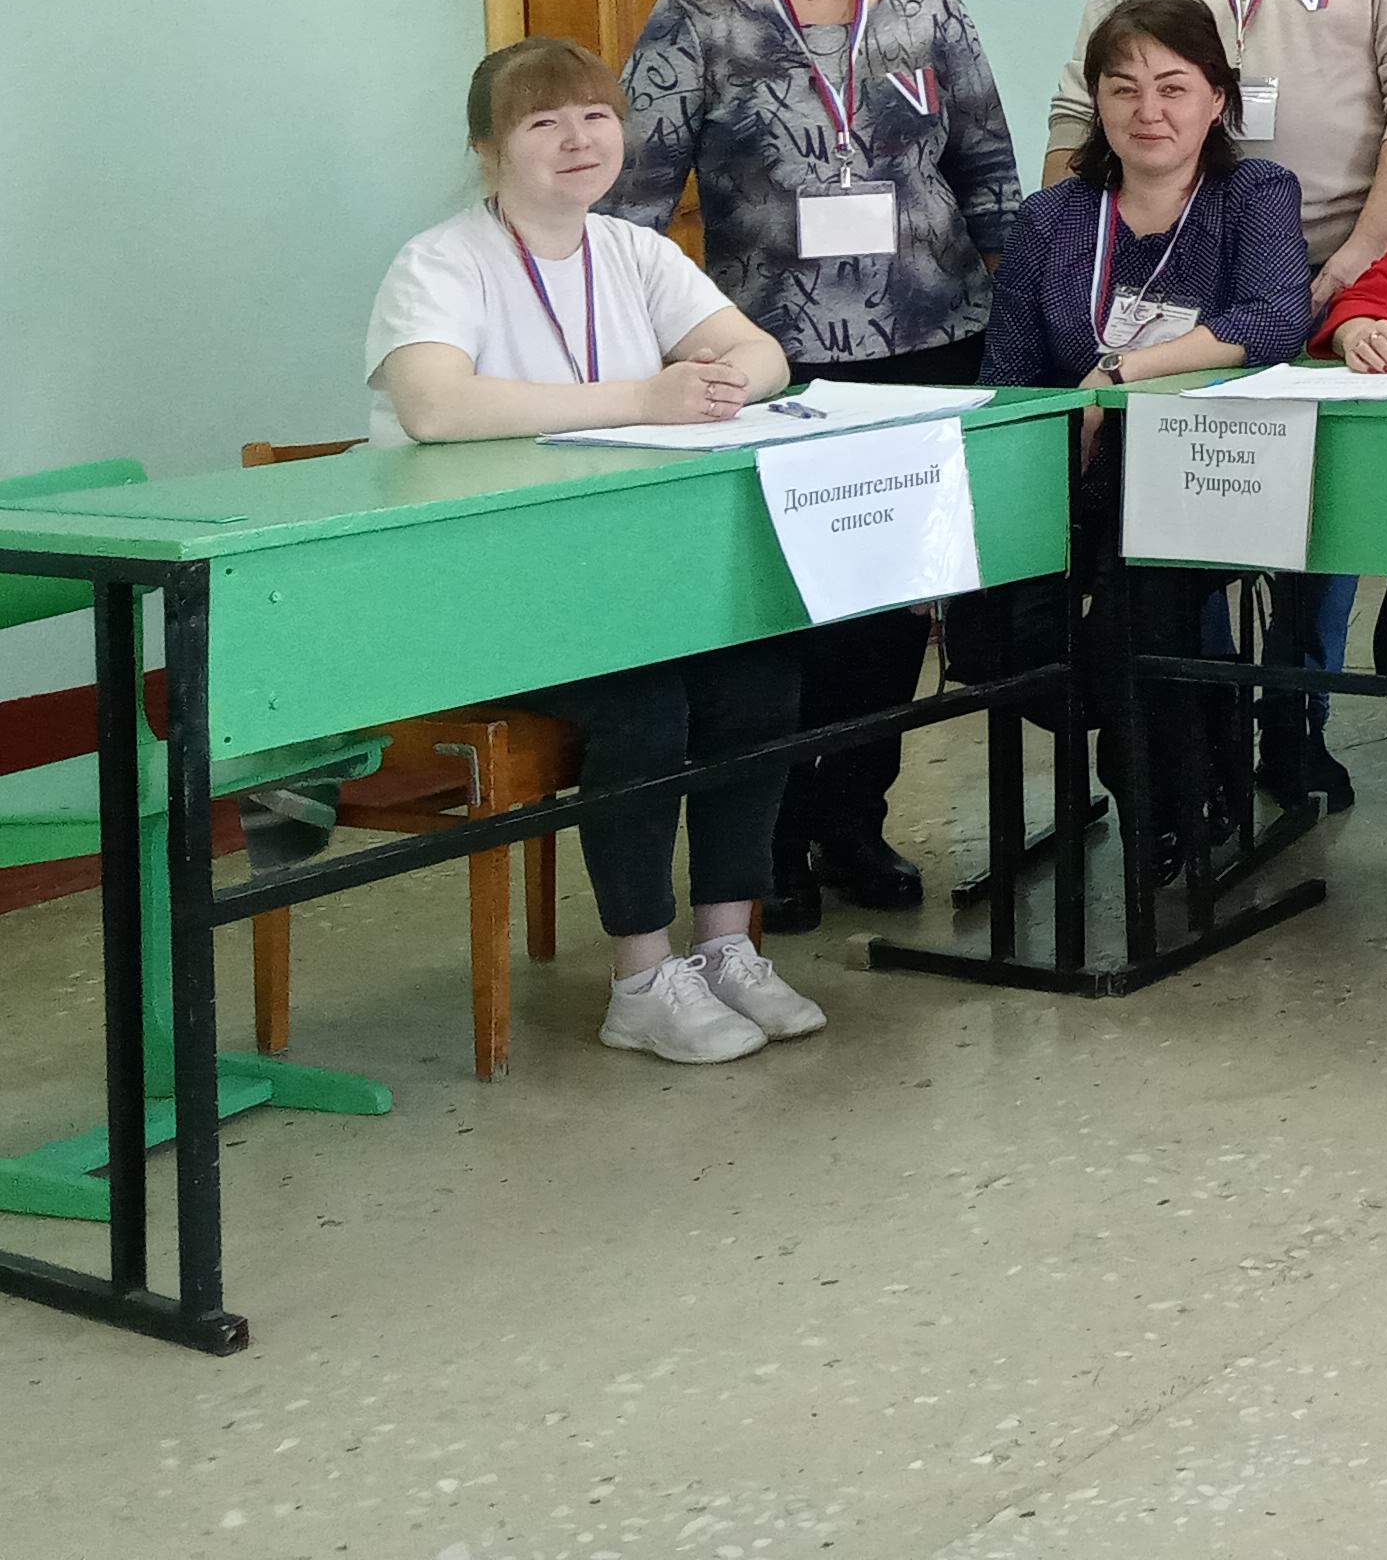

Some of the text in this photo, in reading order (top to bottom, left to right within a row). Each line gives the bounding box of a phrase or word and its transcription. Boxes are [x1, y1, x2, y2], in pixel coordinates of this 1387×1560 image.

[1158, 414, 1286, 439] дер.Норепсола
[1191, 443, 1255, 467] Нуръял
[784, 464, 940, 514] Дополнительный
[1184, 472, 1261, 497] Рушродо
[831, 508, 894, 532] список
